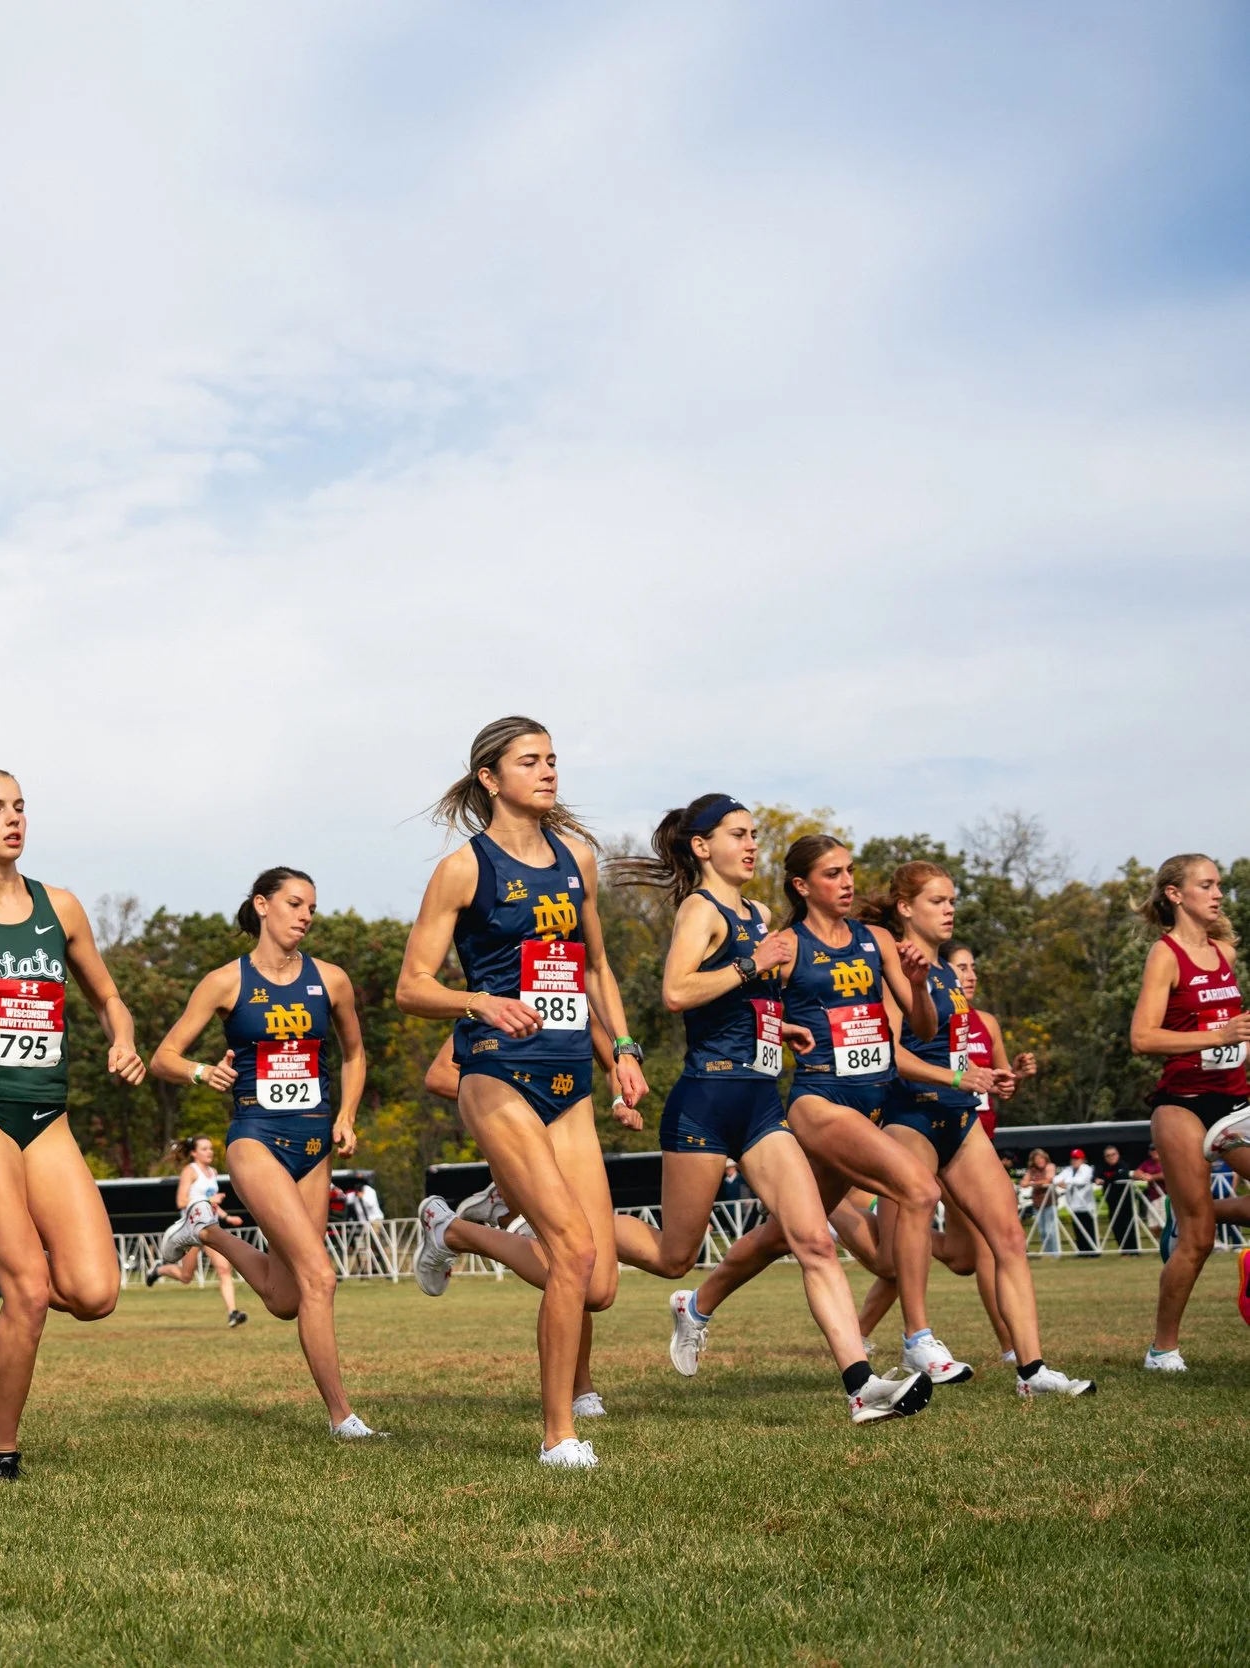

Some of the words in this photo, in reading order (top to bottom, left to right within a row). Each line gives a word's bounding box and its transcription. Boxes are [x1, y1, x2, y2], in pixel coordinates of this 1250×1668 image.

[504, 888, 528, 901] ACC
[6, 1007, 48, 1019] WISCONSIN
[534, 996, 576, 1022] 885
[0, 1017, 54, 1029] INVITATIONAL
[0, 1034, 48, 1060] 795
[1213, 1045, 1240, 1064] 927
[762, 1046, 778, 1070] 891
[848, 1047, 881, 1069] 884
[270, 1083, 310, 1103] 892
